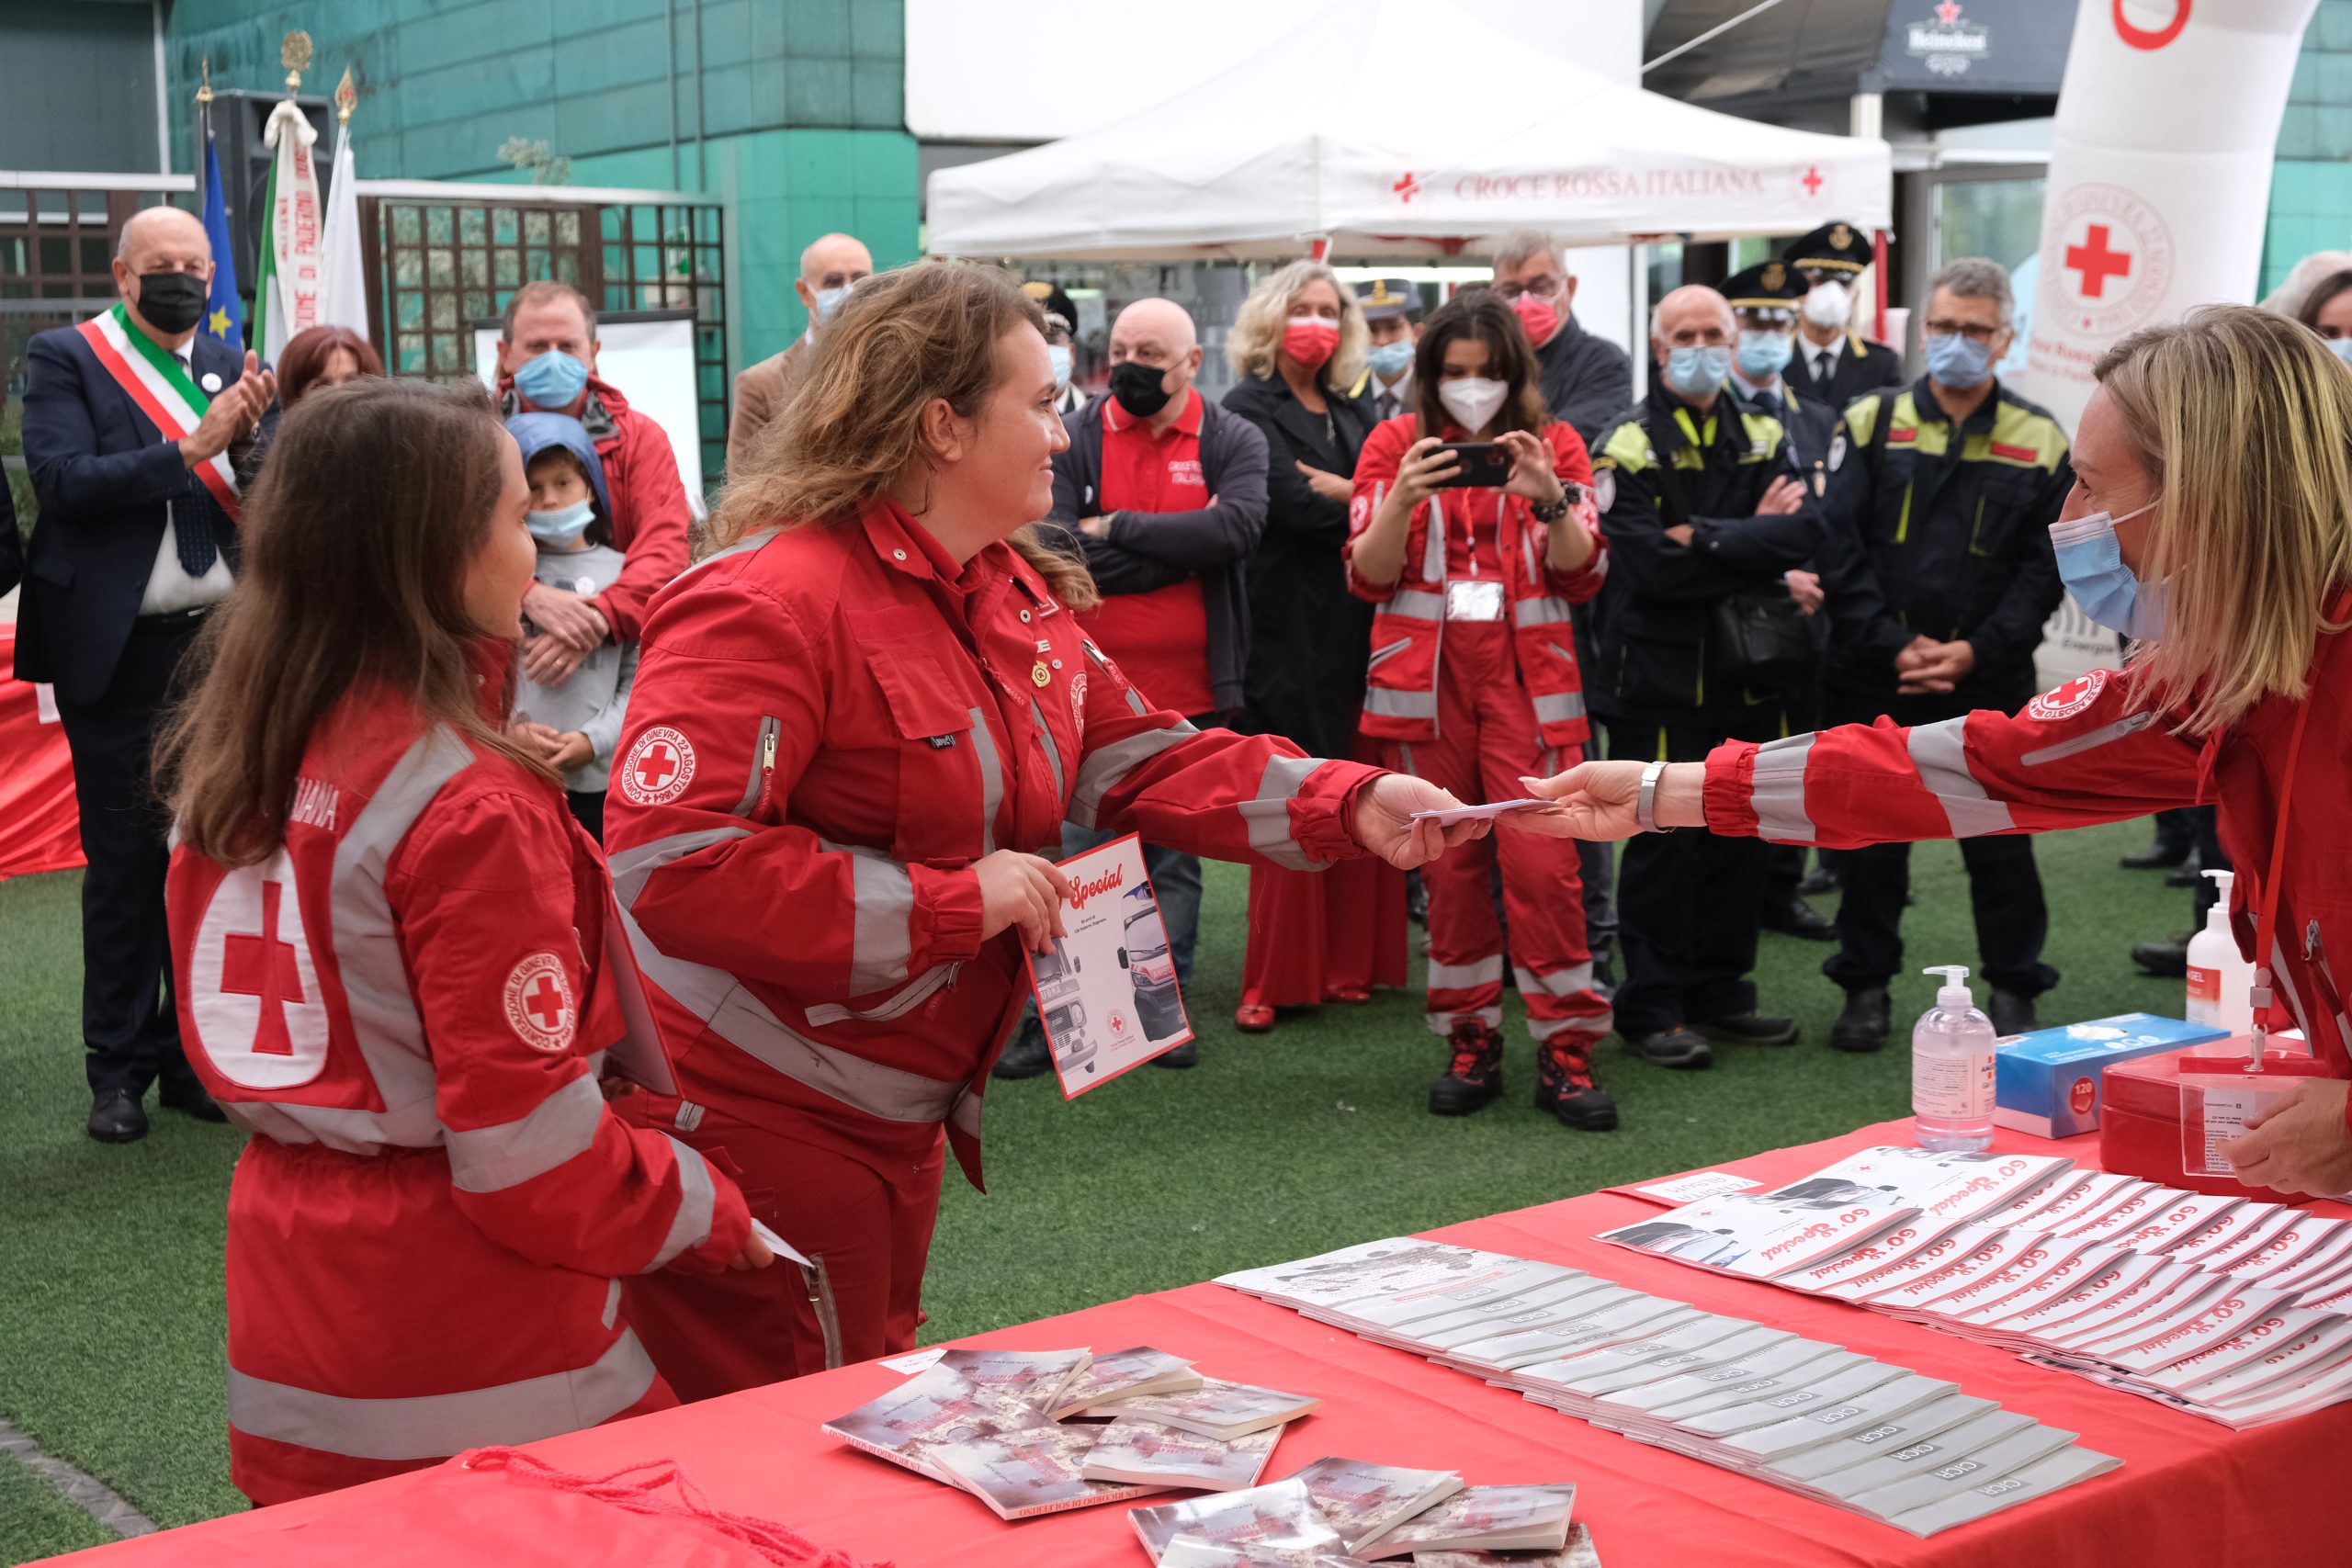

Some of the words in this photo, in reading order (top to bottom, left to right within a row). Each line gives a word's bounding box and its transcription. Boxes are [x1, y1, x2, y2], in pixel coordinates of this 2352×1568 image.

[1909, 28, 1986, 51] Heineken
[1454, 175, 1554, 200] CROCE
[1555, 172, 1640, 198] ROSSA
[1651, 169, 1766, 195] ITALIANA
[2044, 701, 2086, 718] AGOSTO
[638, 738, 646, 749] DI
[646, 728, 679, 743] GINEVRA
[677, 739, 689, 752] 22
[624, 747, 642, 801] CONVENZIONE
[673, 753, 694, 794] AGOSTO
[653, 790, 674, 803] 1864
[1070, 863, 1123, 910] Special
[1152, 964, 1173, 980] AMBU
[2074, 1081, 2092, 1095] 120
[1929, 1176, 1999, 1216] Special
[1760, 1223, 1838, 1262] Special
[1809, 1247, 1886, 1280] Special
[1903, 1262, 1977, 1296] Special
[1455, 1287, 1490, 1301] CICR
[1483, 1299, 1520, 1313] CICR
[1512, 1311, 1549, 1324] CICR
[2136, 1320, 2216, 1355] Special
[2168, 1337, 2253, 1372] Special
[1702, 1369, 1745, 1382] CICR
[1770, 1392, 1814, 1407] CICR
[1816, 1406, 1859, 1424] CICR
[829, 1429, 867, 1450] SOLFERINO
[1855, 1426, 1897, 1443] CICR
[868, 1443, 876, 1453] DI
[1892, 1443, 1934, 1461] CICR
[876, 1447, 909, 1469] RICORDO
[1935, 1461, 1977, 1480] CICR
[1125, 1488, 1139, 1498] UN
[1977, 1479, 2021, 1495] CICR
[1072, 1497, 1083, 1506] DI
[1083, 1491, 1124, 1506] RICORDO
[1019, 1499, 1071, 1517] SOLFERINO
